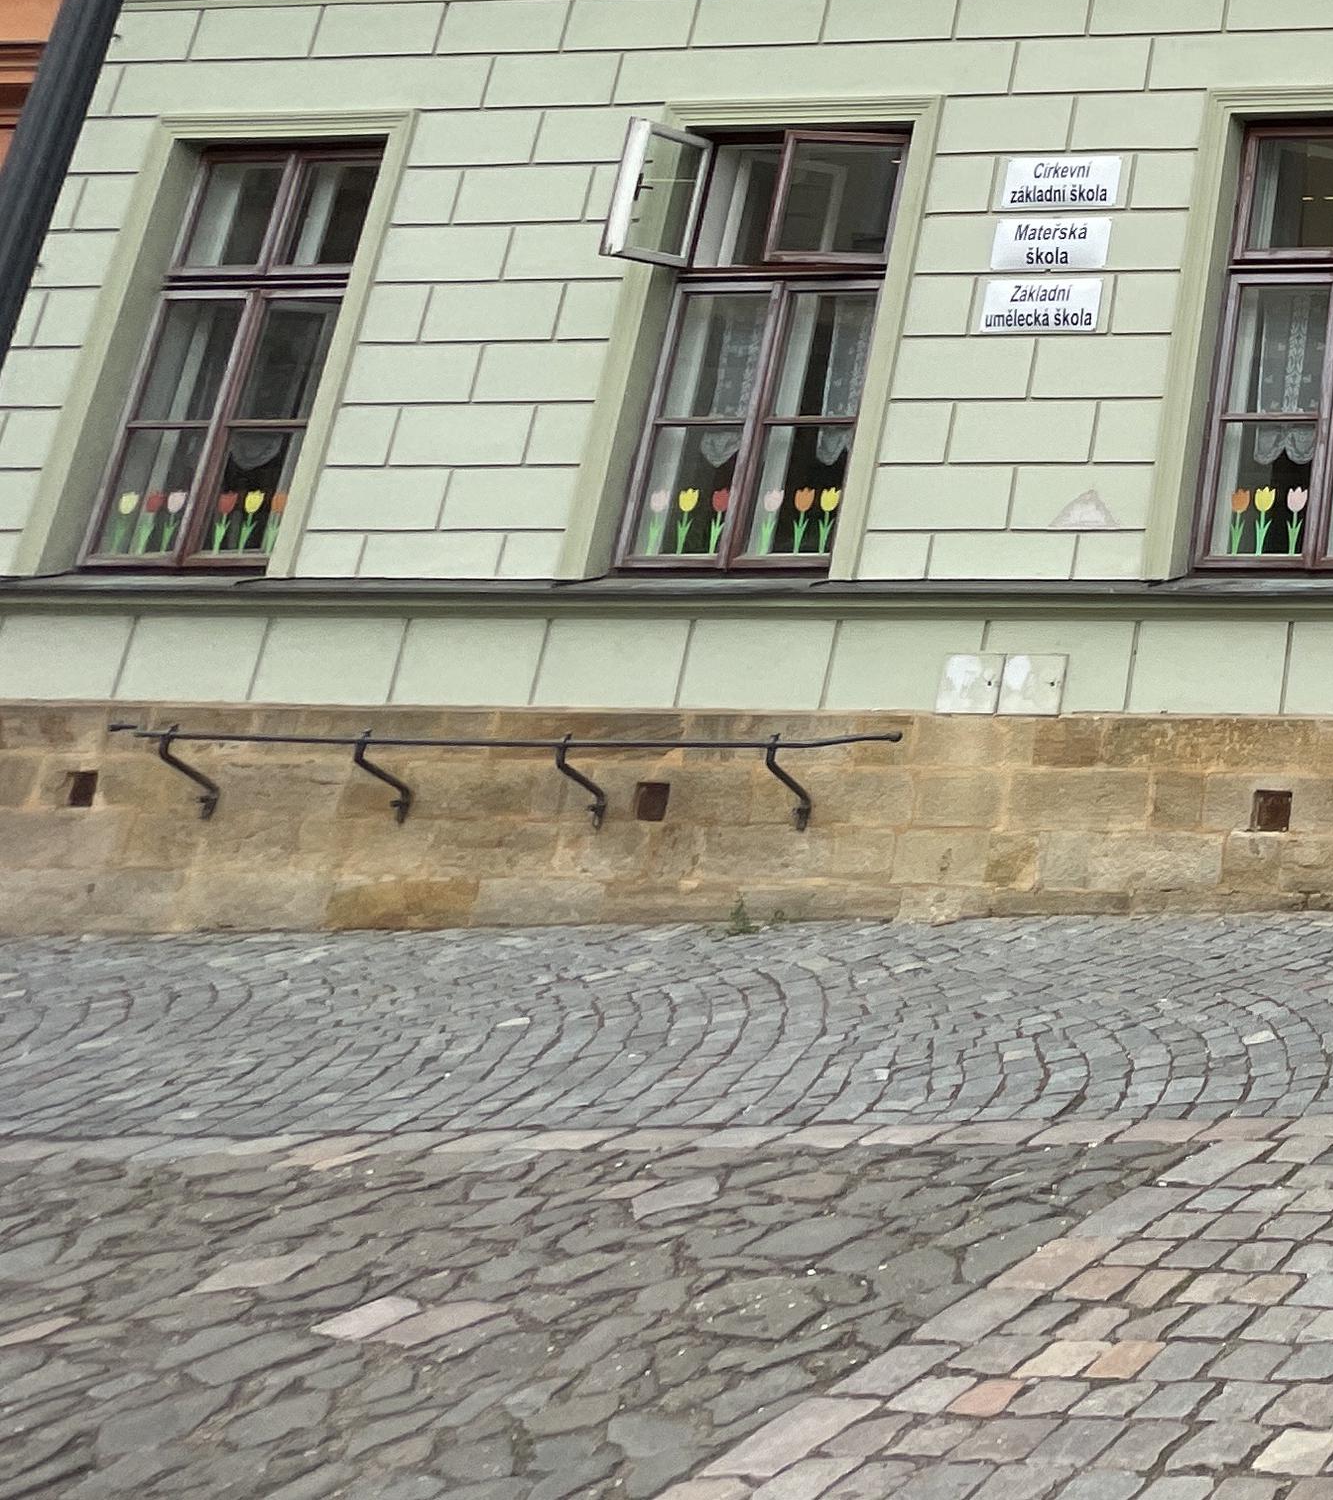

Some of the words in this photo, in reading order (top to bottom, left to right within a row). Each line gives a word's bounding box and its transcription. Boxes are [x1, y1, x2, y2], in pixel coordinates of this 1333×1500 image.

[1010, 184, 1067, 204] základní
[1070, 184, 1108, 202] škola
[1014, 223, 1088, 241] Mateřská
[1026, 246, 1069, 265] škola
[1010, 284, 1072, 303] Základní
[985, 307, 1050, 328] umělecká
[1054, 307, 1093, 326] škola
